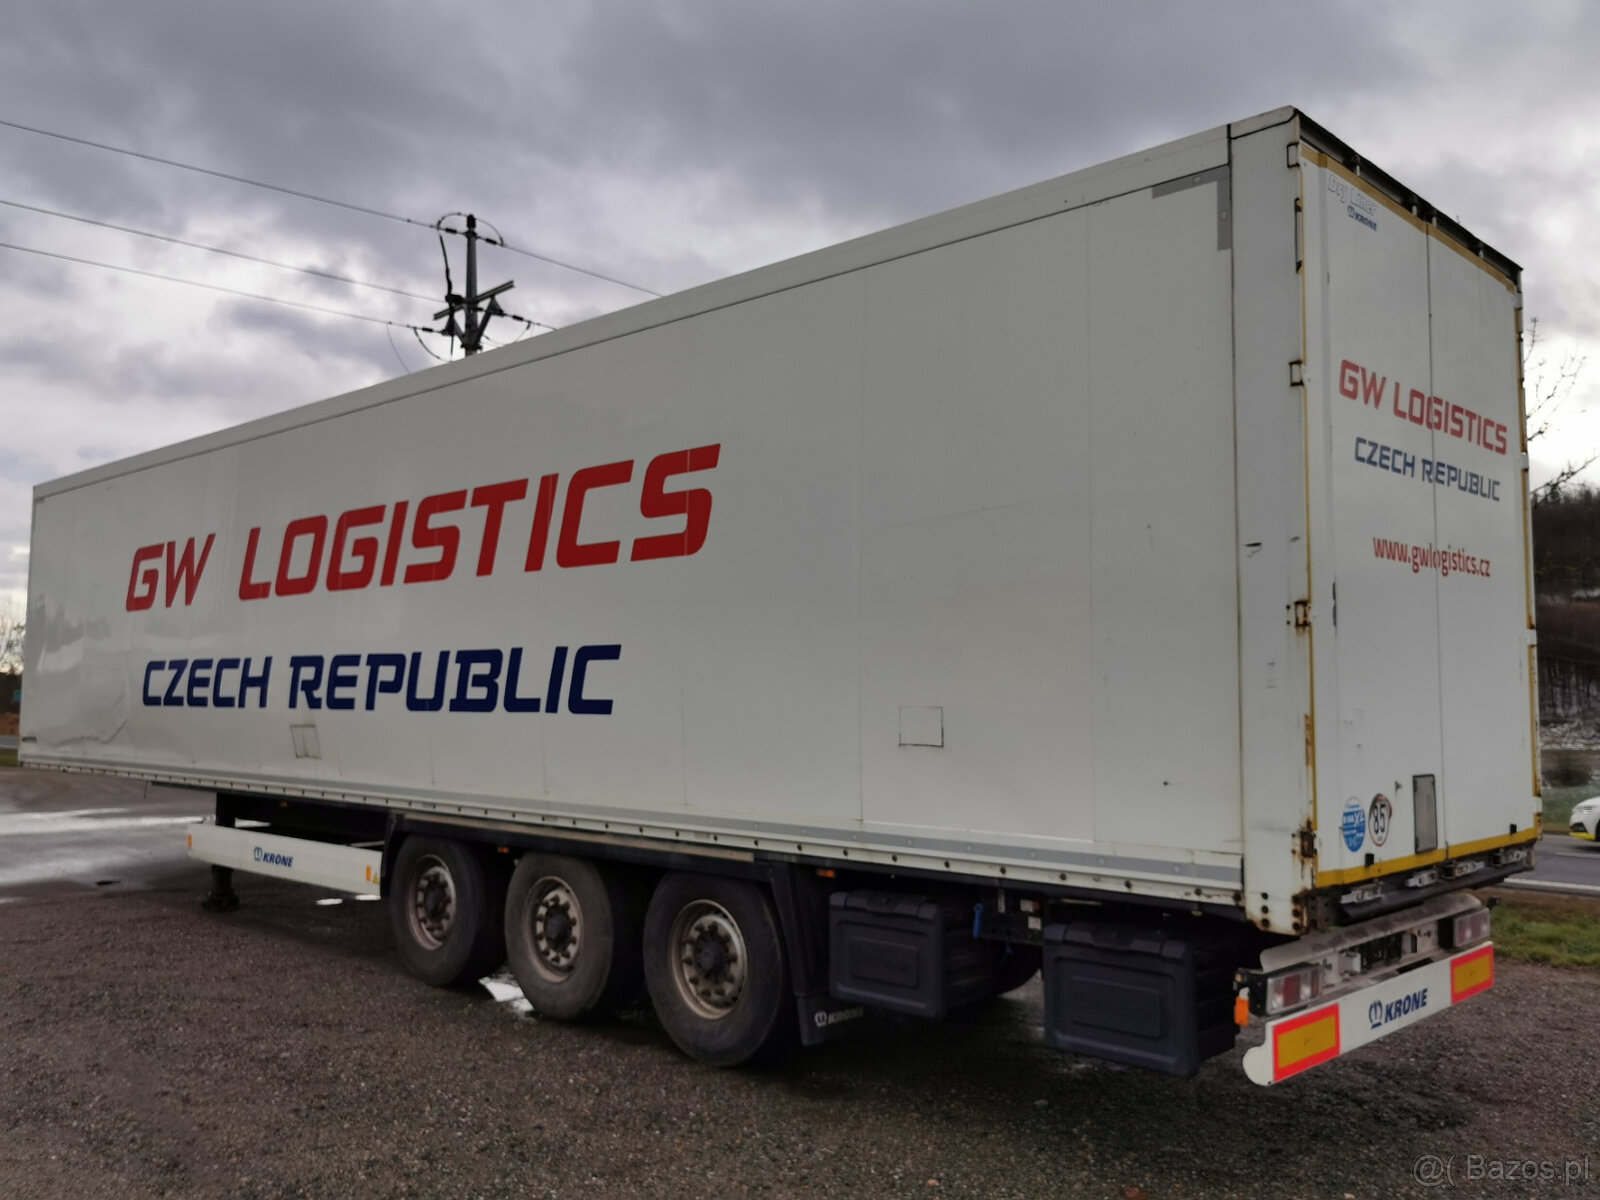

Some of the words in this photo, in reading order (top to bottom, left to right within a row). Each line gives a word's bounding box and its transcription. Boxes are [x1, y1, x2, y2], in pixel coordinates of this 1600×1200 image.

[1339, 359, 1386, 410] GW
[1393, 381, 1507, 455] LOGISTICS
[1354, 437, 1415, 478] CZECH
[1421, 458, 1501, 502] REPUBLIC
[126, 532, 216, 612] GW
[238, 443, 721, 601] LOGISTICS
[1372, 537, 1491, 578] www.gwlogistics.cz
[142, 656, 273, 708] CZECH
[288, 644, 622, 715] REPUBLIC
[1373, 803, 1386, 834] 85
[262, 852, 294, 868] KRONE
[1385, 988, 1428, 1024] KRONE
